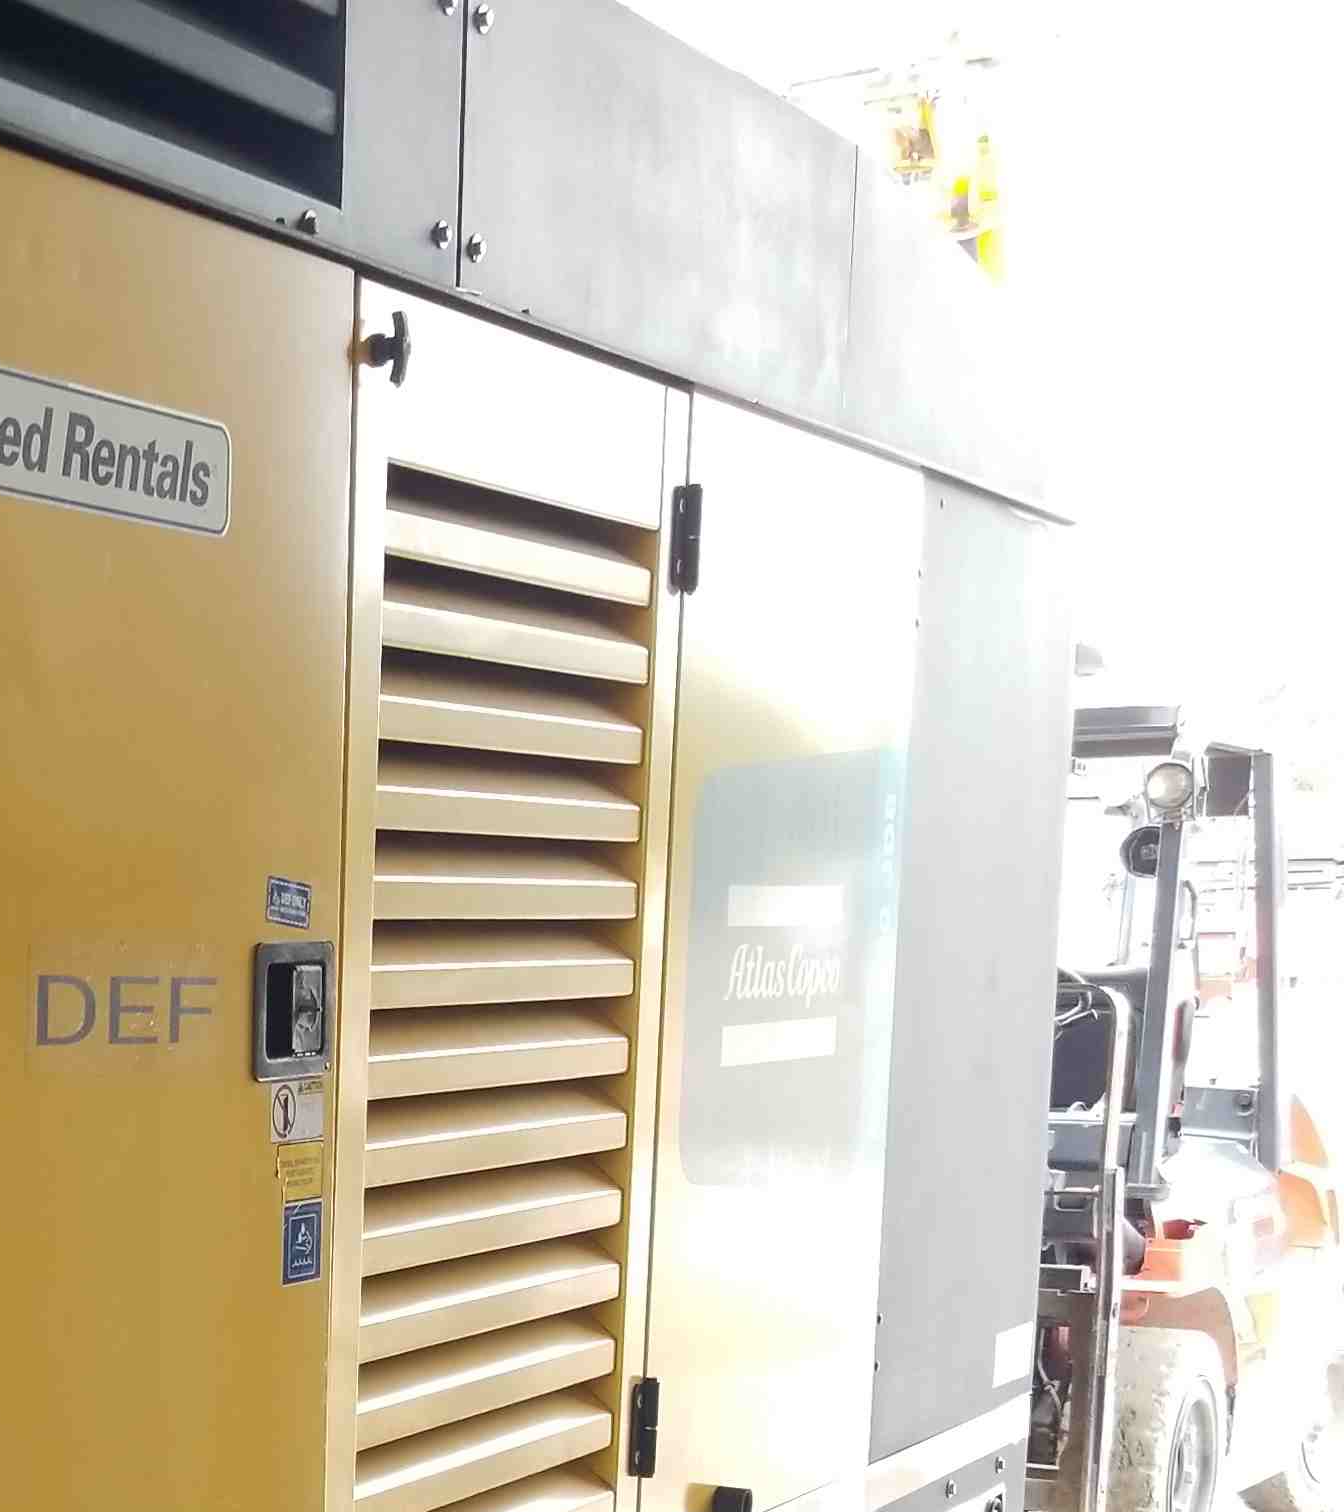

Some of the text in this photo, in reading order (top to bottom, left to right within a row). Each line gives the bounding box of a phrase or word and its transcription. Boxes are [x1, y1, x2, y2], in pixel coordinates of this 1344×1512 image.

[62, 410, 211, 508] Rentals
[35, 974, 218, 1047] DEF
[724, 943, 842, 1008] Atlas Copco
